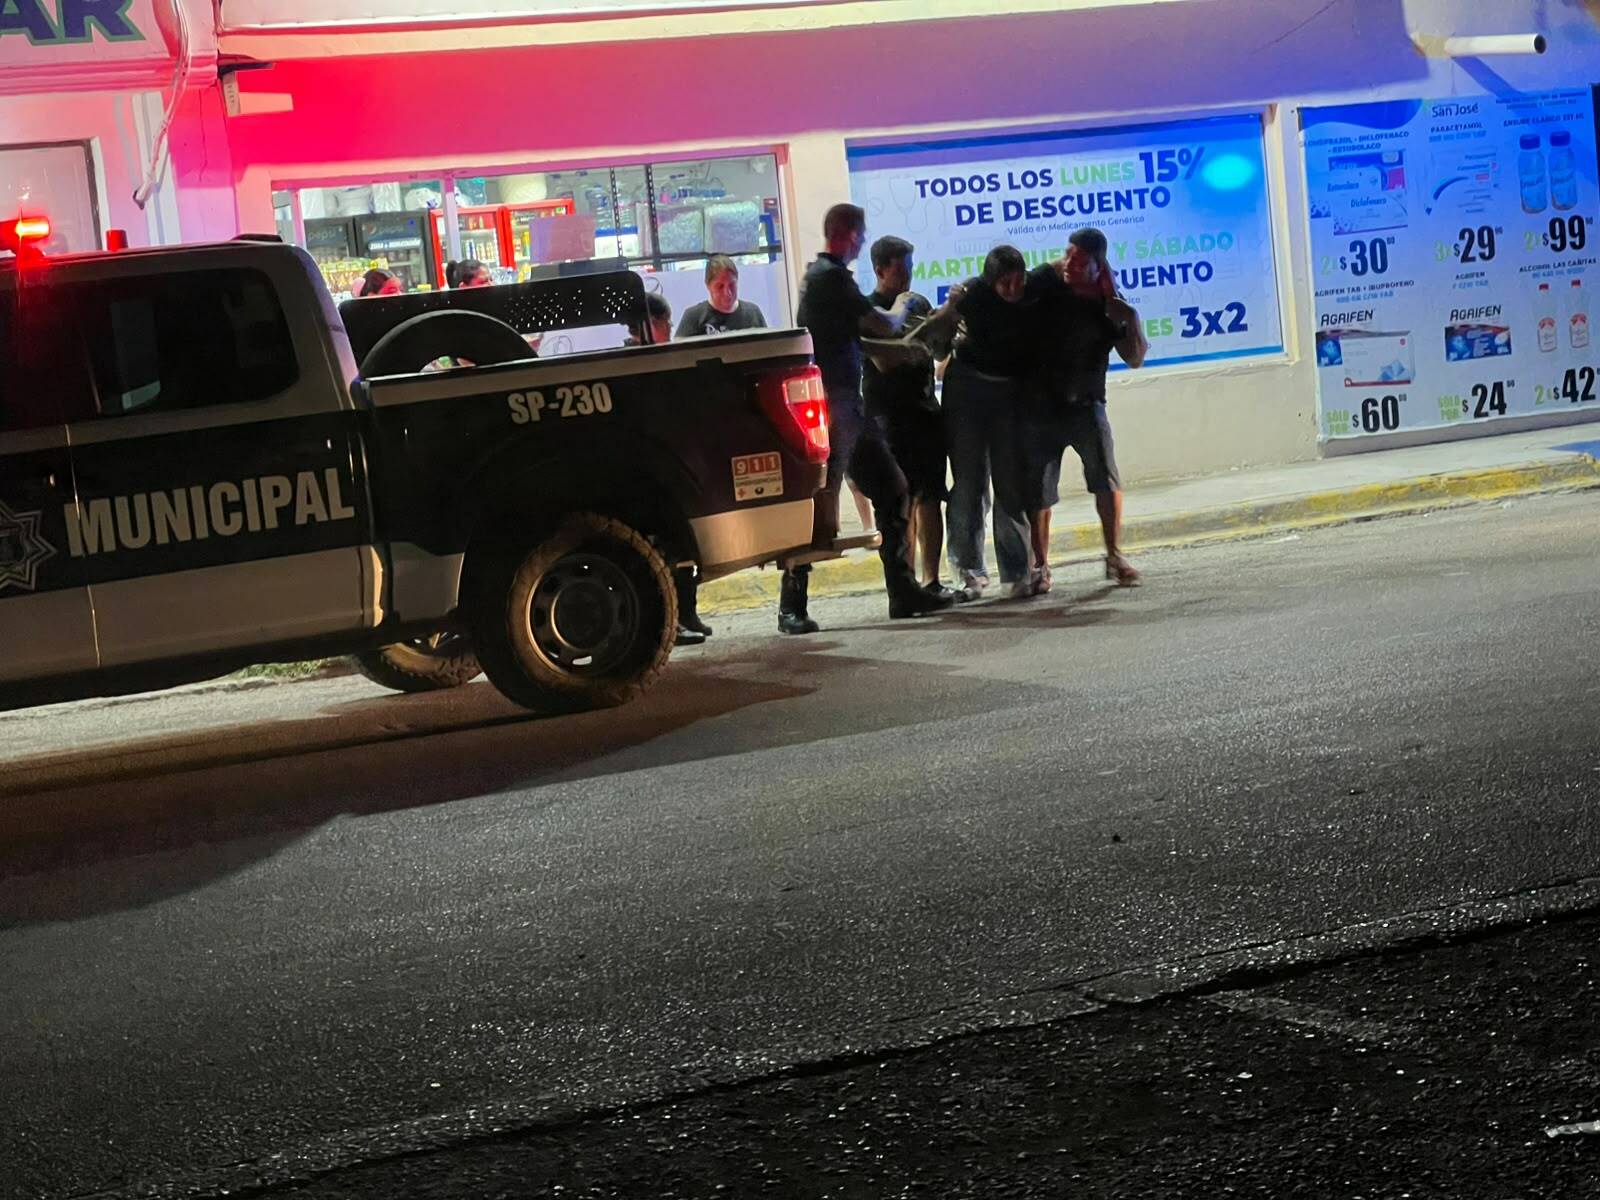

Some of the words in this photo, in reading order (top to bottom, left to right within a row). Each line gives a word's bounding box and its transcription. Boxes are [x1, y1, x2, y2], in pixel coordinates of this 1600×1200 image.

[1430, 122, 1483, 133] PARACETAMOL
[1432, 105, 1452, 118] San
[1456, 101, 1479, 116] José
[914, 173, 1001, 199] TODOS
[1007, 168, 1053, 191] LOS
[1060, 160, 1136, 186] LUNES
[1139, 146, 1205, 184] 15%
[955, 202, 994, 226] DE
[1002, 185, 1171, 222] DESCUENTO
[1007, 225, 1034, 235] Válido
[1036, 224, 1047, 232] en
[1049, 216, 1106, 232] Medicamento
[1107, 214, 1145, 226] Genérico
[1543, 215, 1585, 252] $99
[1113, 242, 1129, 261] Y
[1135, 231, 1234, 260] SÁBADO
[1339, 237, 1388, 277] $30
[1453, 225, 1496, 264] $29
[1314, 289, 1345, 298] AGRIFEN
[1347, 286, 1361, 294] TAB
[1368, 279, 1415, 291] IBUPROFENO
[1179, 301, 1248, 338] 3x2
[1320, 308, 1374, 327] AGRIFEN
[1449, 304, 1502, 322] AGRIFEN
[1462, 381, 1507, 419] $24
[1553, 366, 1596, 403] $42
[507, 382, 613, 425] SP-230
[1352, 395, 1400, 433] $60
[736, 455, 776, 474] 911
[64, 467, 355, 558] MUNICIPAL
